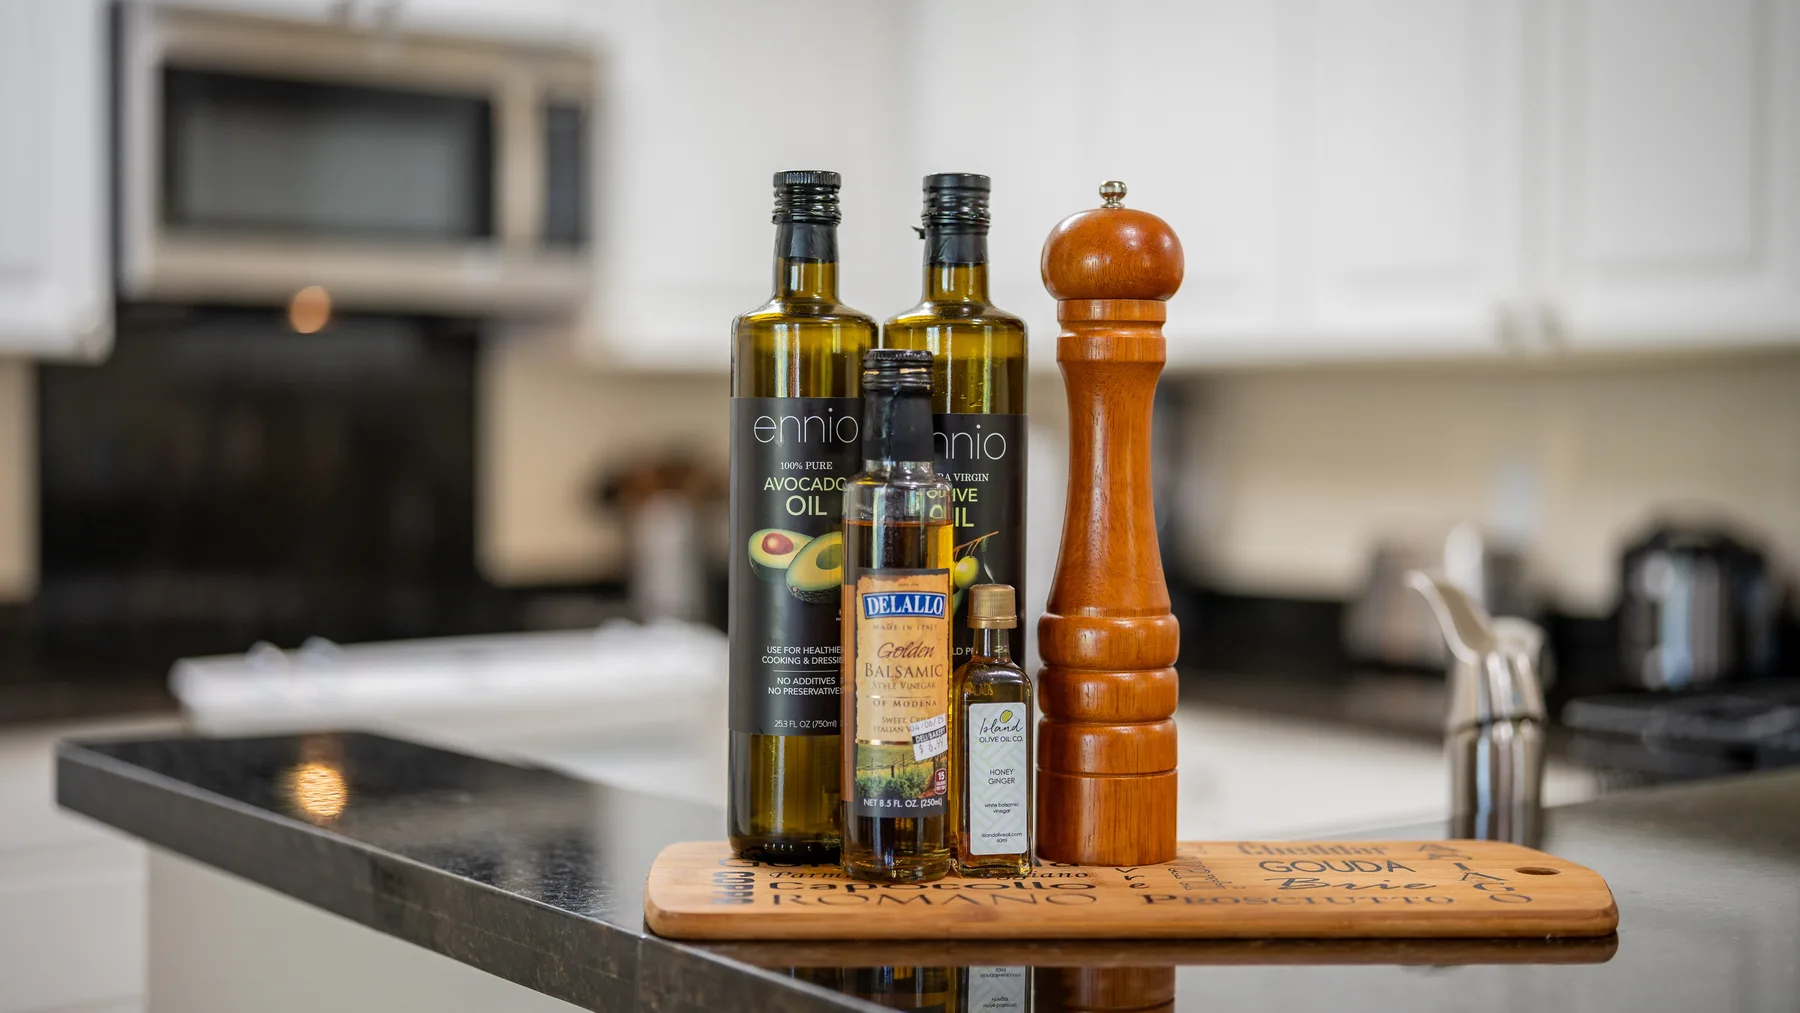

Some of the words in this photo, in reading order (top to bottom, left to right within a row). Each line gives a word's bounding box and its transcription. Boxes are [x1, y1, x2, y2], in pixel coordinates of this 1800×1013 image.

[753, 407, 859, 444] ennio
[933, 424, 1007, 461] nnio
[780, 461, 803, 471] 100%
[805, 461, 833, 471] PURE
[954, 473, 989, 482] VIRGIN
[785, 495, 828, 516] OIL
[866, 595, 943, 615] DELALLO
[766, 646, 782, 654] USE
[783, 646, 801, 655] FOR
[803, 646, 843, 655] HEALTHIE
[877, 641, 935, 659] Golden
[761, 656, 801, 665] COOKING
[803, 657, 810, 665] &
[811, 656, 843, 665] DRESSI
[865, 662, 943, 679] BALSAMIC
[777, 677, 791, 685] NO
[792, 677, 836, 685] ADDITIVES
[872, 682, 896, 690] STYLE
[900, 682, 936, 690] VINEGAR
[768, 687, 782, 695] NO
[893, 700, 937, 708] MODENA
[789, 720, 797, 728] FL
[799, 720, 811, 728] OZ
[873, 725, 904, 733] ITALIAN
[979, 717, 1023, 735] Island
[938, 772, 945, 780] 15
[987, 777, 1015, 785] GINGER
[863, 798, 878, 806] NET
[879, 799, 892, 808] 8.5
[904, 799, 919, 808] OZ.
[1258, 860, 1416, 873] GOUDA
[769, 881, 1096, 892] Capocollo
[1264, 877, 1437, 890] Brie
[773, 893, 1097, 906] ROMANO
